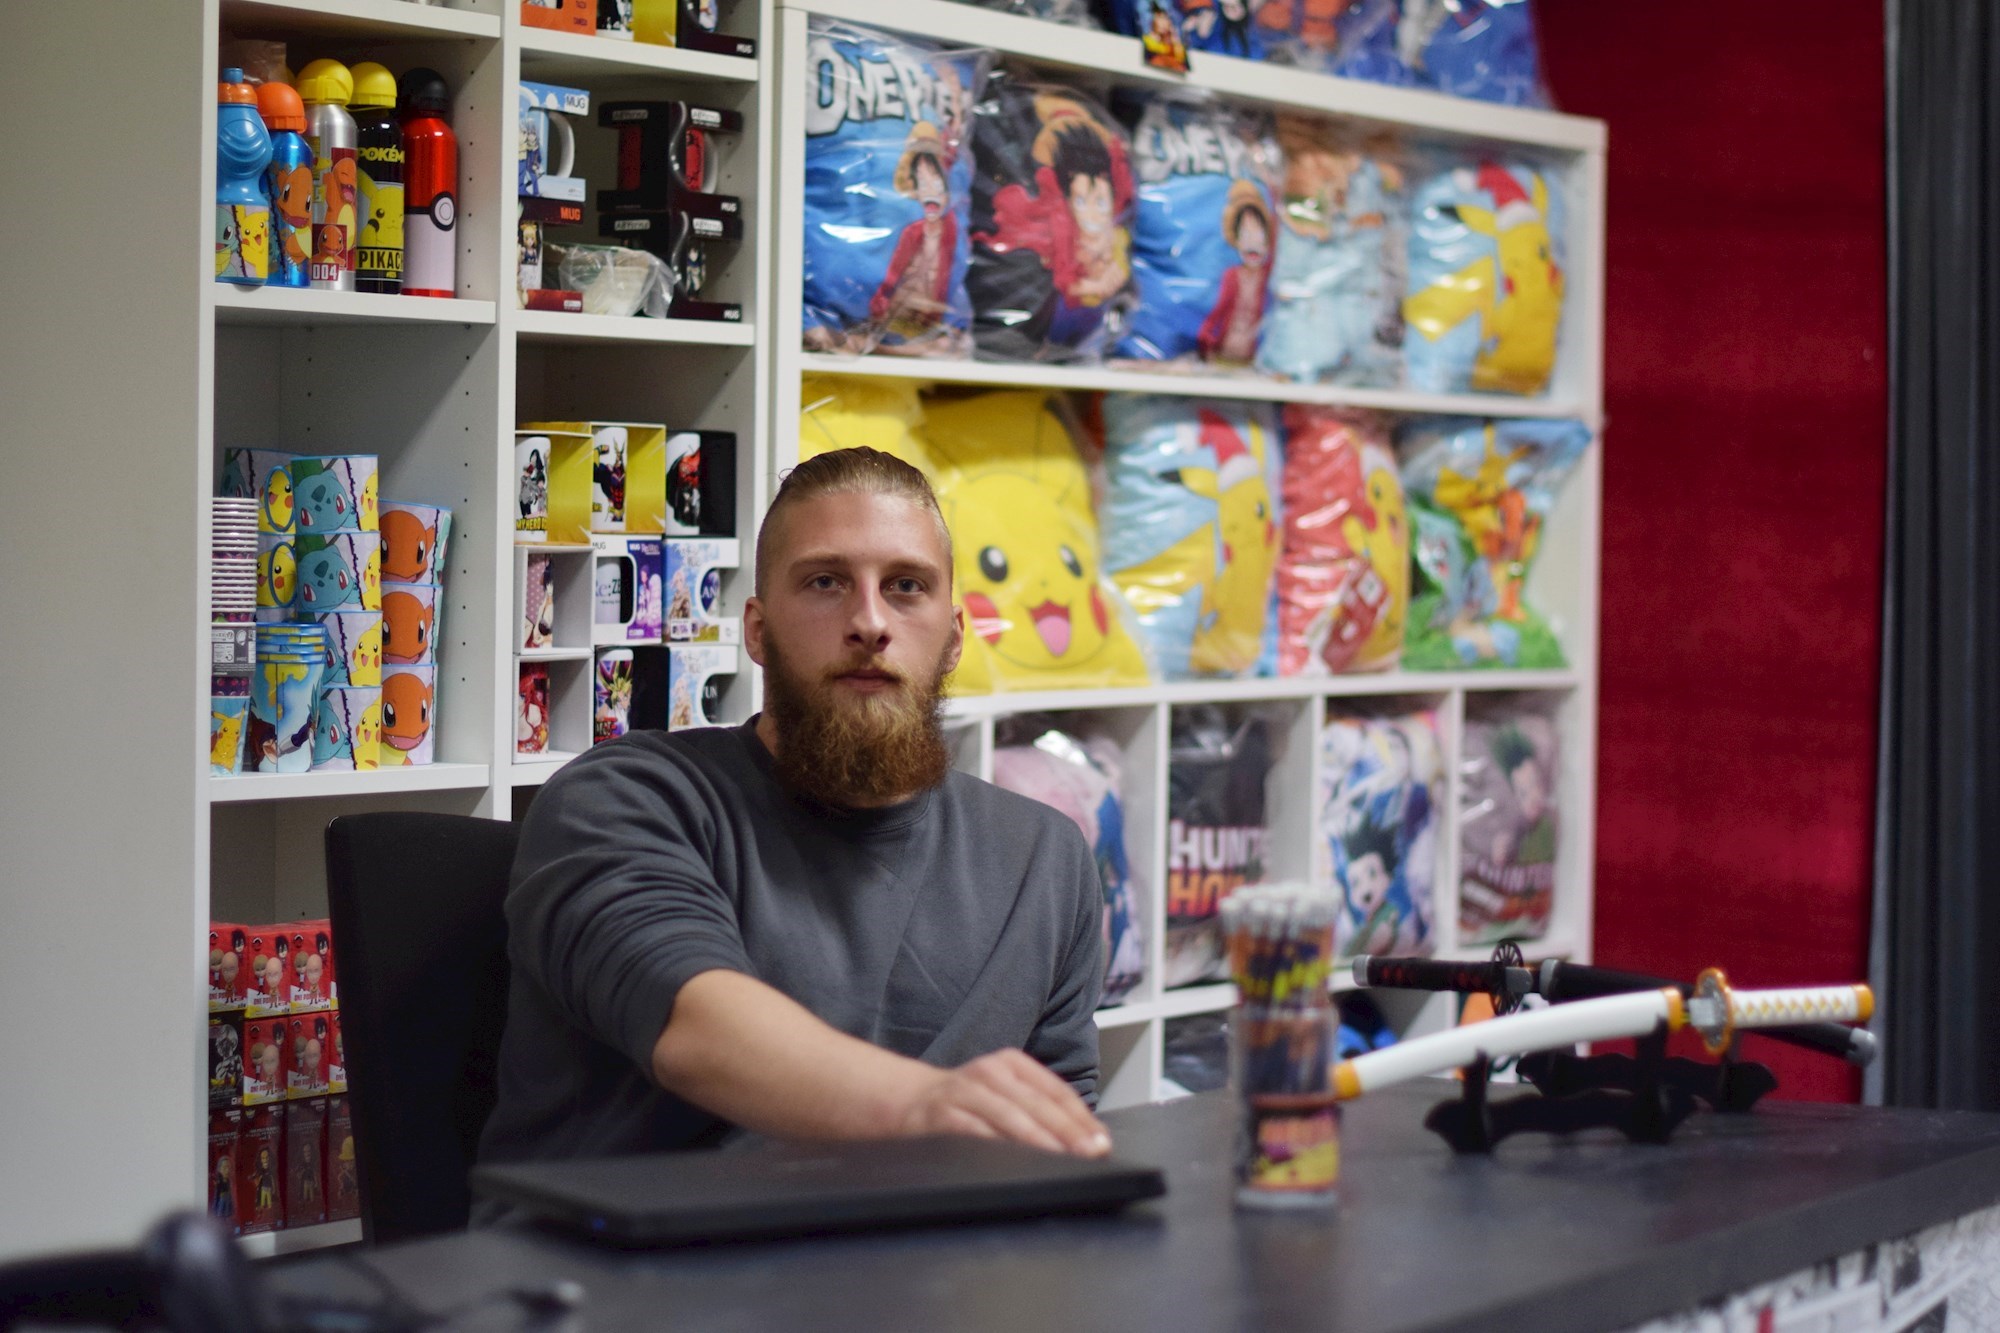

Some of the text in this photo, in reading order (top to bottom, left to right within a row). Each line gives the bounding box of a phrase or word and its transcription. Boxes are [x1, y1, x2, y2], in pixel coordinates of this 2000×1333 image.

[566, 95, 586, 109] MUG
[560, 207, 580, 220] MUG
[359, 251, 404, 269] PIKAC
[312, 264, 338, 280] 004
